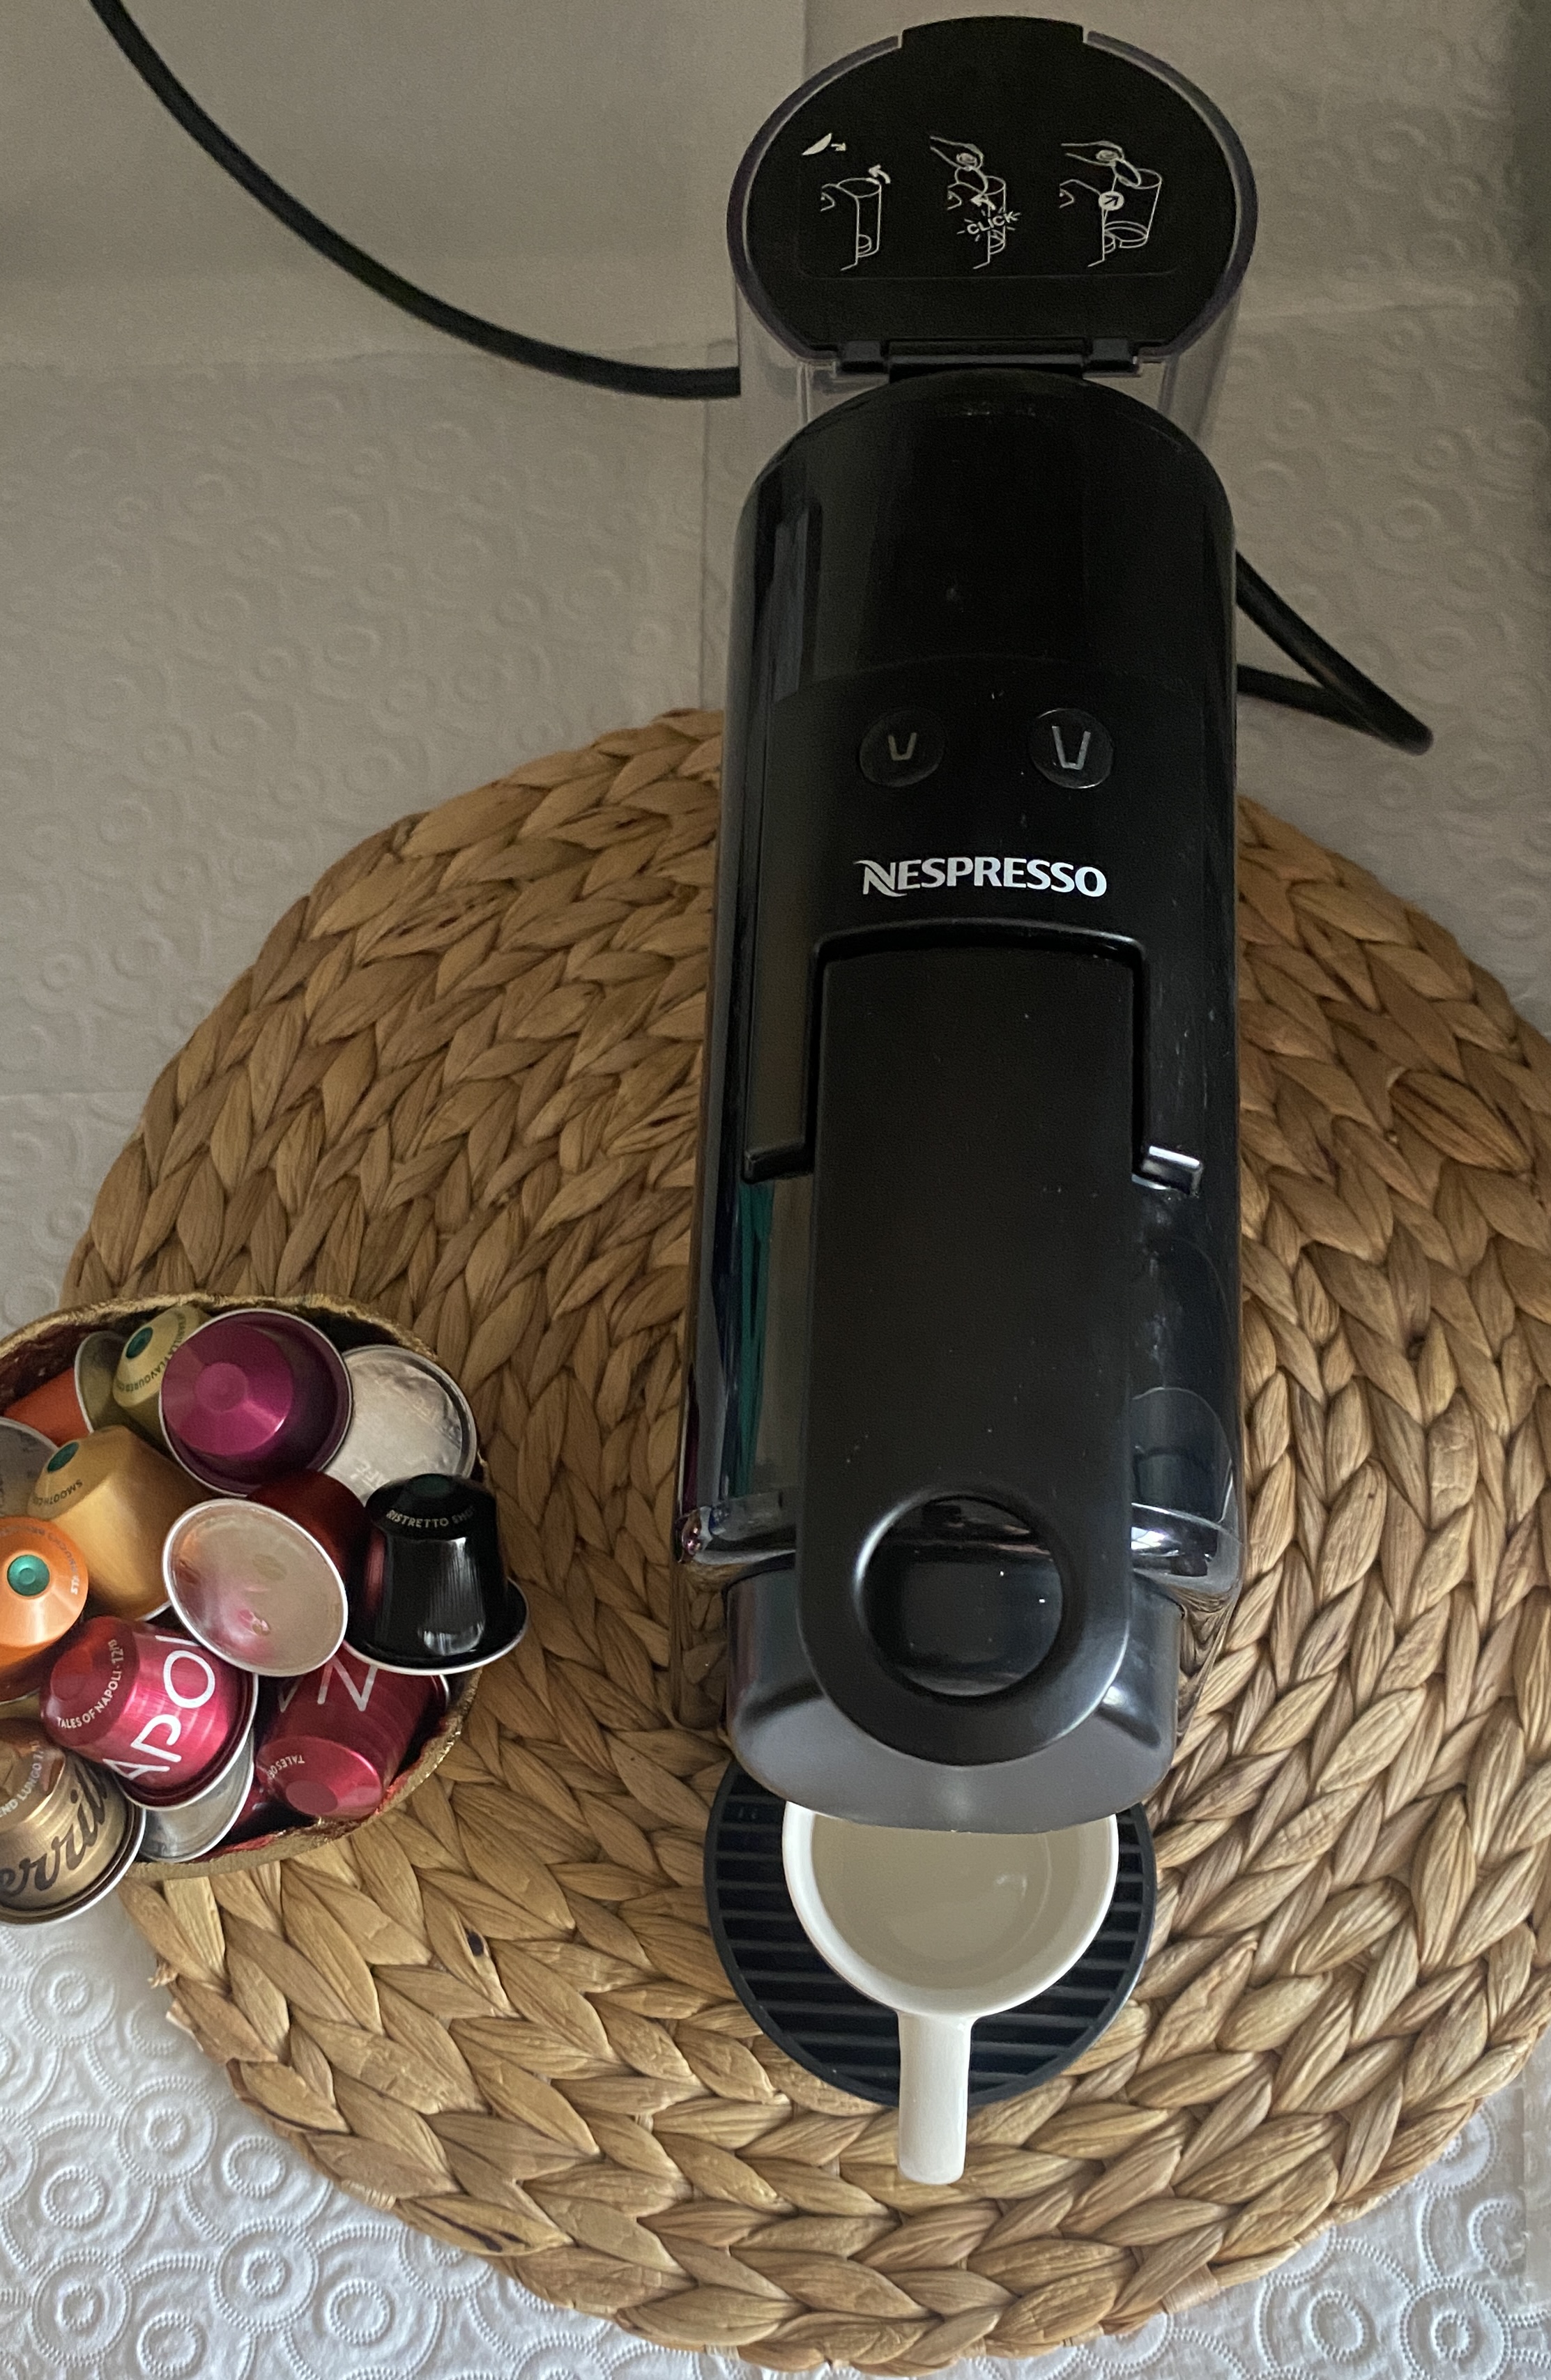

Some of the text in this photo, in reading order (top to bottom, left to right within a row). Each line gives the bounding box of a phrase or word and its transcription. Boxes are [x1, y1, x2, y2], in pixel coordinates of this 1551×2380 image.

[966, 210, 1018, 235] CLICK
[853, 856, 1107, 898] NESPRESSO
[385, 1509, 450, 1528] RISTRETTO
[56, 1716, 82, 1729] TALES
[82, 1708, 95, 1723] OF
[94, 1670, 122, 1714] NAPOLI
[275, 1754, 305, 1771] TALES
[17, 1761, 43, 1801] LUNGO
